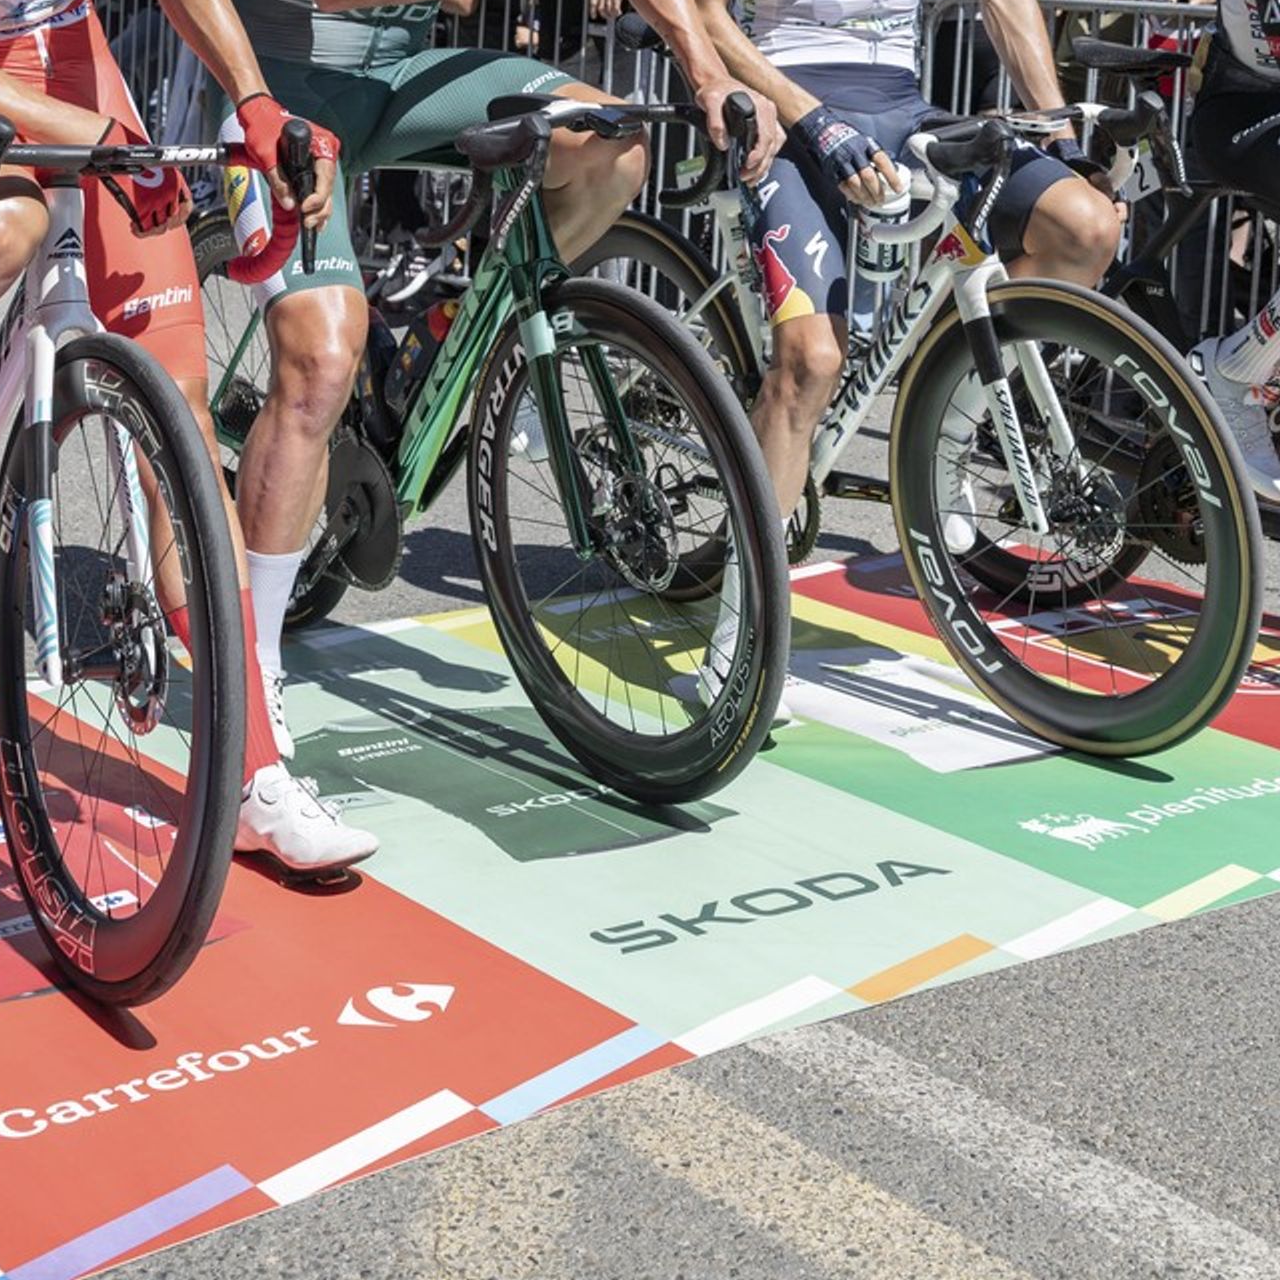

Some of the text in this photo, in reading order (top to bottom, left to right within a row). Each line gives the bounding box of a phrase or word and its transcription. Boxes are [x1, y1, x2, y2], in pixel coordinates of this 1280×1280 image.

[291, 256, 354, 276] Sntini
[123, 283, 193, 320] Santini
[478, 342, 528, 553] NTRAGER
[336, 736, 411, 758] Santini
